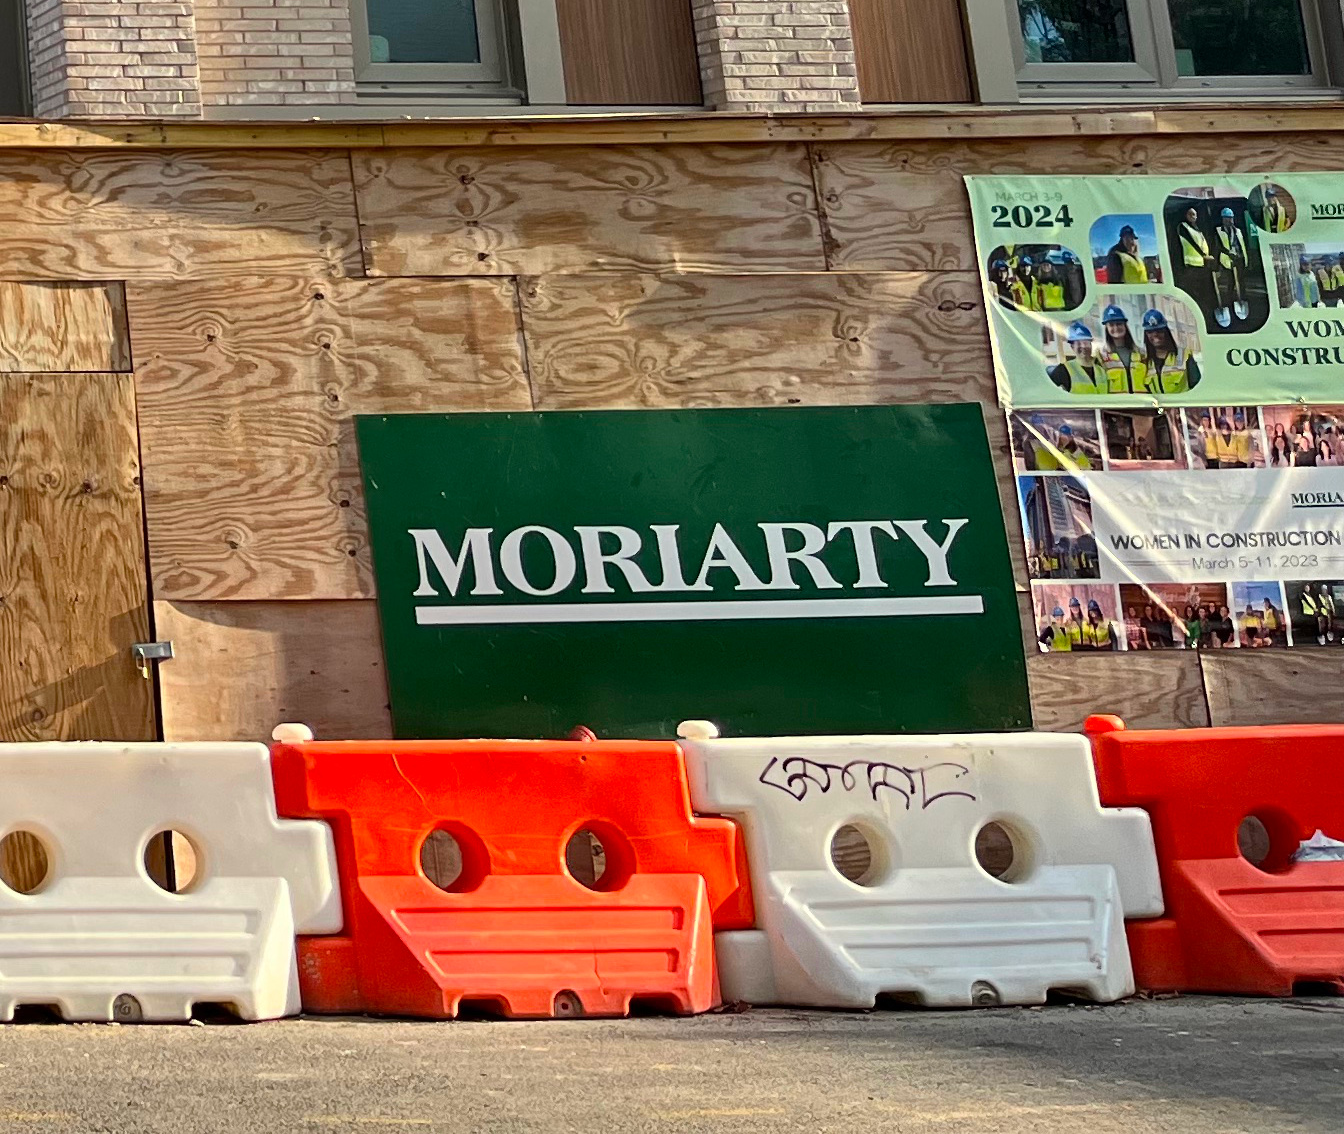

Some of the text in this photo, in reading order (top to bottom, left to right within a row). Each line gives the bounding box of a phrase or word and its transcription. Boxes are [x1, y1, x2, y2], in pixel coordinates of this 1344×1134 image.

[995, 191, 1063, 202] MARCH 3-9
[991, 204, 1074, 228] 2024
[1284, 319, 1344, 338] WO
[1110, 530, 1342, 550] WOMEN IN CONSTRUCTION
[407, 518, 969, 597] MORIARTY
[1192, 555, 1234, 570] March
[1281, 554, 1319, 568] 2023
